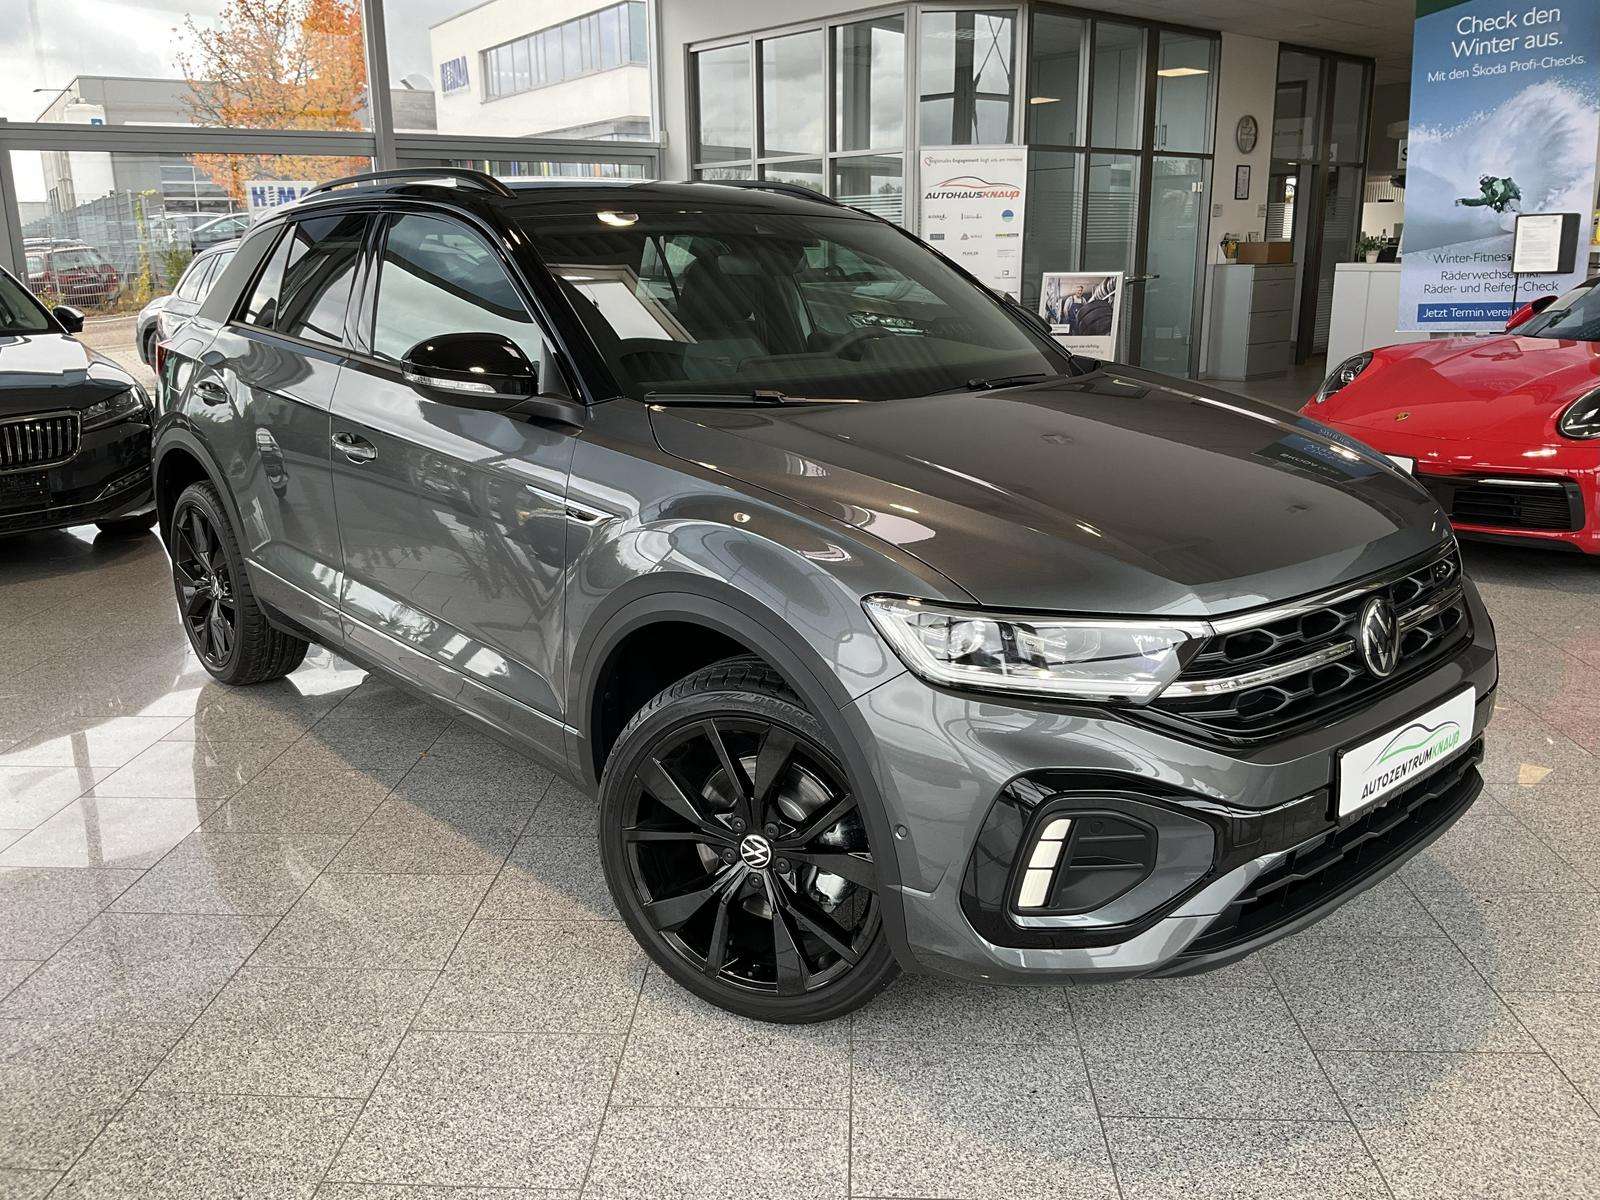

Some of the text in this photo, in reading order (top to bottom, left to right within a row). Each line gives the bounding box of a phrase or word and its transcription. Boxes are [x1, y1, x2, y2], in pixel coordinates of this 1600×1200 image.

[1456, 7, 1561, 36] Check den
[1451, 31, 1563, 58] Winter aus.
[1427, 54, 1587, 83] Mit den Škoda Profi-Checks.
[1460, 283, 1481, 293] und
[1423, 308, 1448, 318] Jetzt
[1450, 307, 1484, 317] Termin
